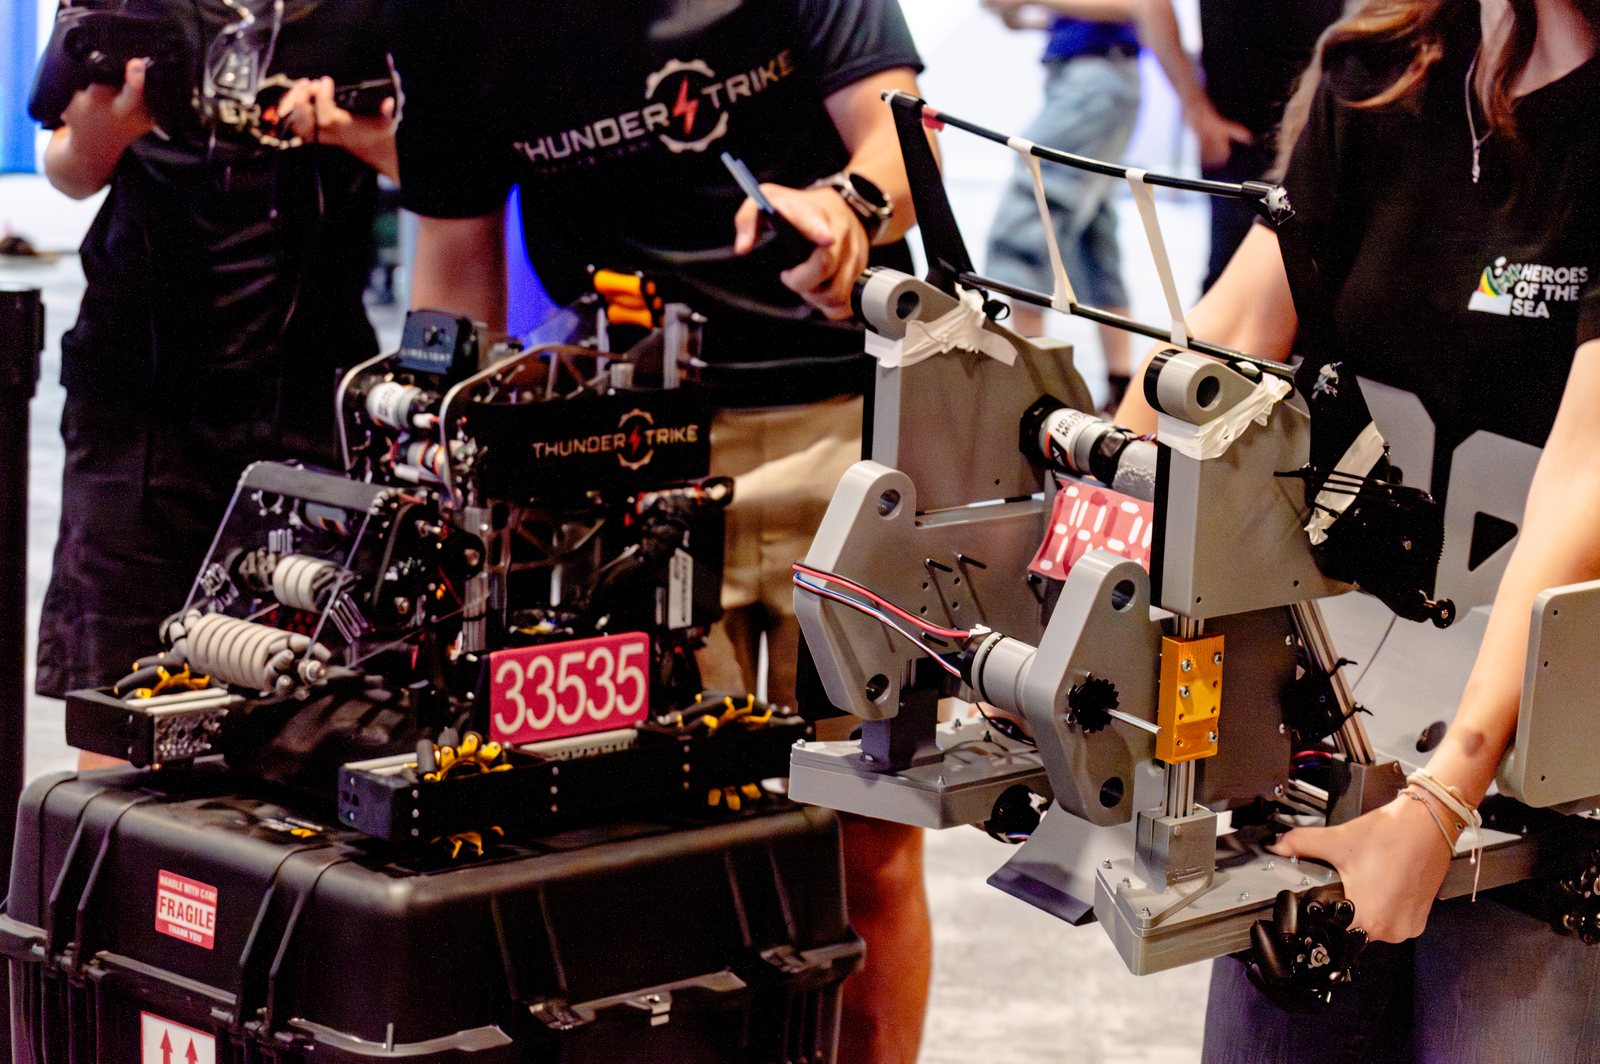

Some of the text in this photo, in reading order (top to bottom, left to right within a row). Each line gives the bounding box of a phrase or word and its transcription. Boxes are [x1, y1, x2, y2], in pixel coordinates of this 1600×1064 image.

[1520, 263, 1589, 284] HEROES
[1513, 280, 1580, 302] OF THE
[1511, 298, 1550, 319] SEA
[532, 424, 698, 458] THUNDER TRIKE
[494, 642, 647, 735] 33535
[159, 895, 214, 930] FRAGILE
